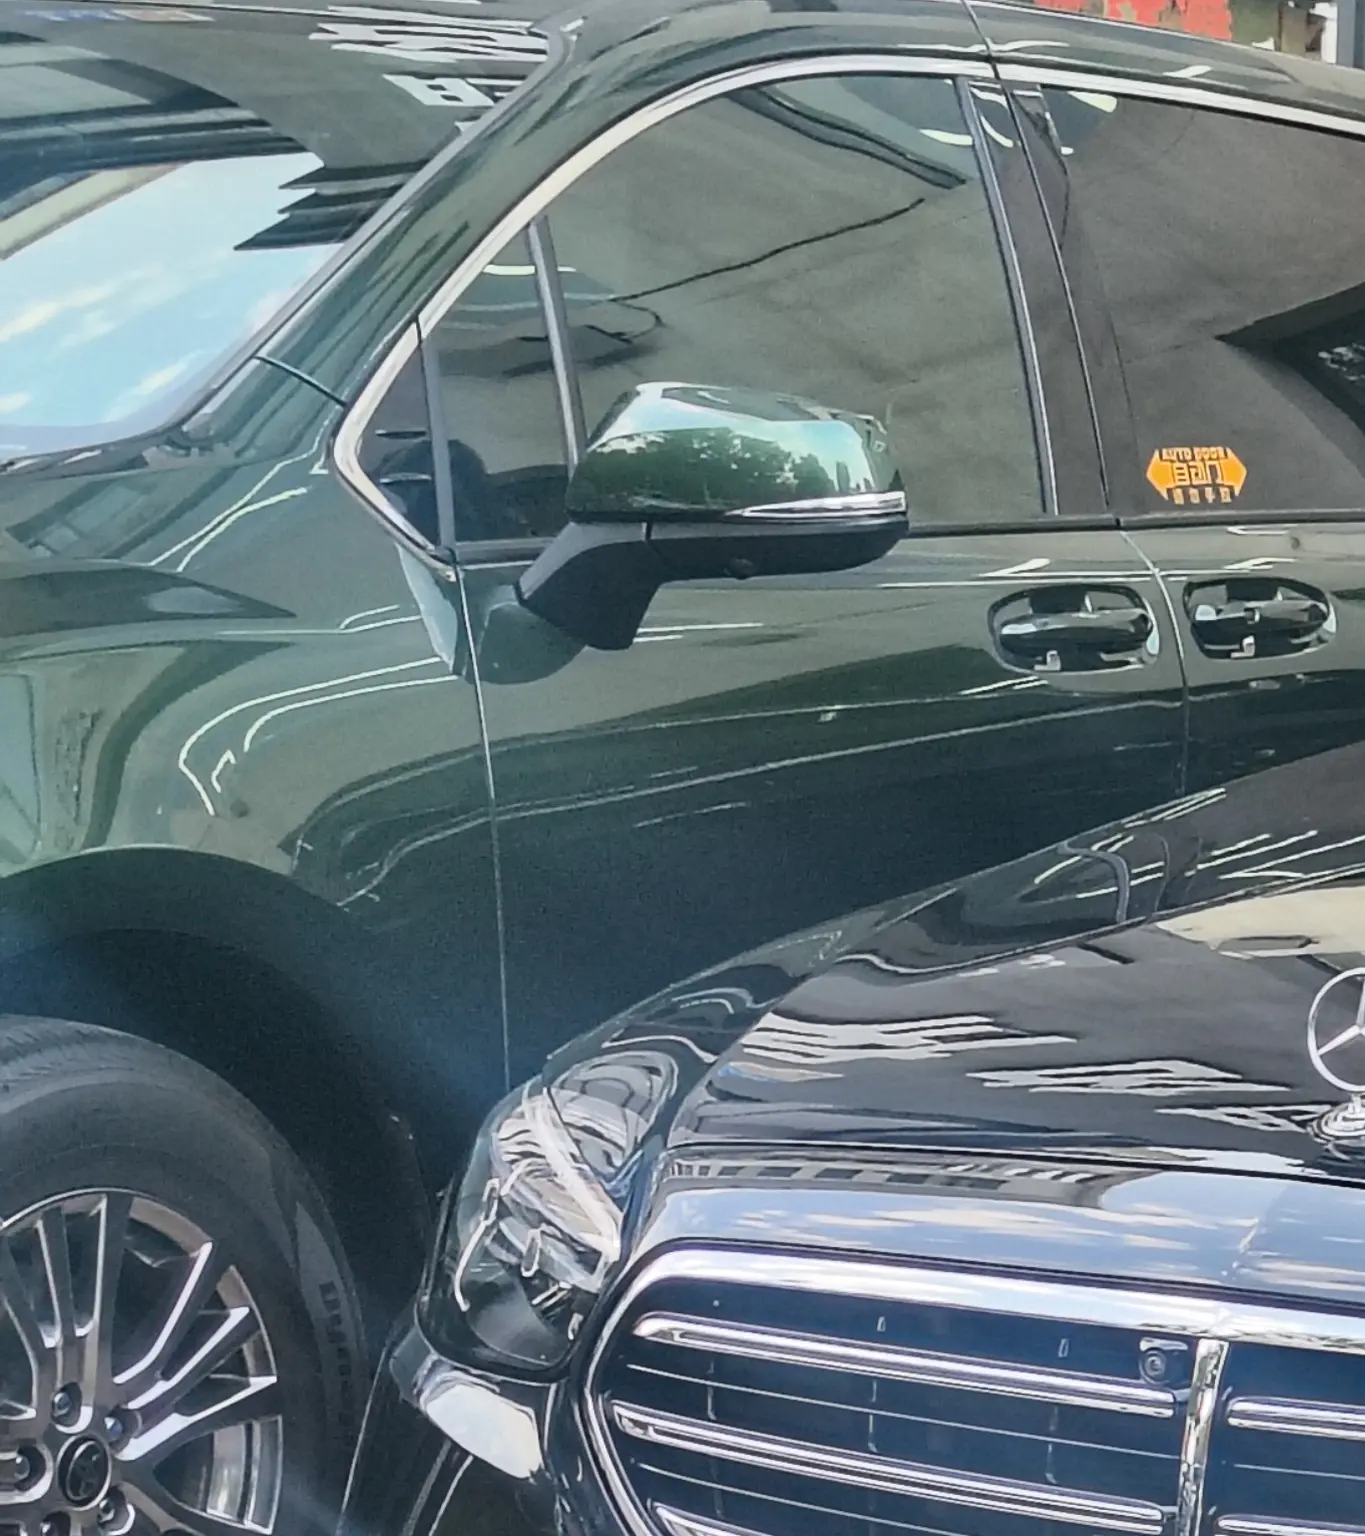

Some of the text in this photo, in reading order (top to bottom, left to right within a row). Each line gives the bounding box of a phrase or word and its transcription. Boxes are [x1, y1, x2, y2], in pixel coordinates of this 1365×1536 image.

[1161, 446, 1226, 461] AUTO DOOR
[1173, 461, 1224, 486] 自动门
